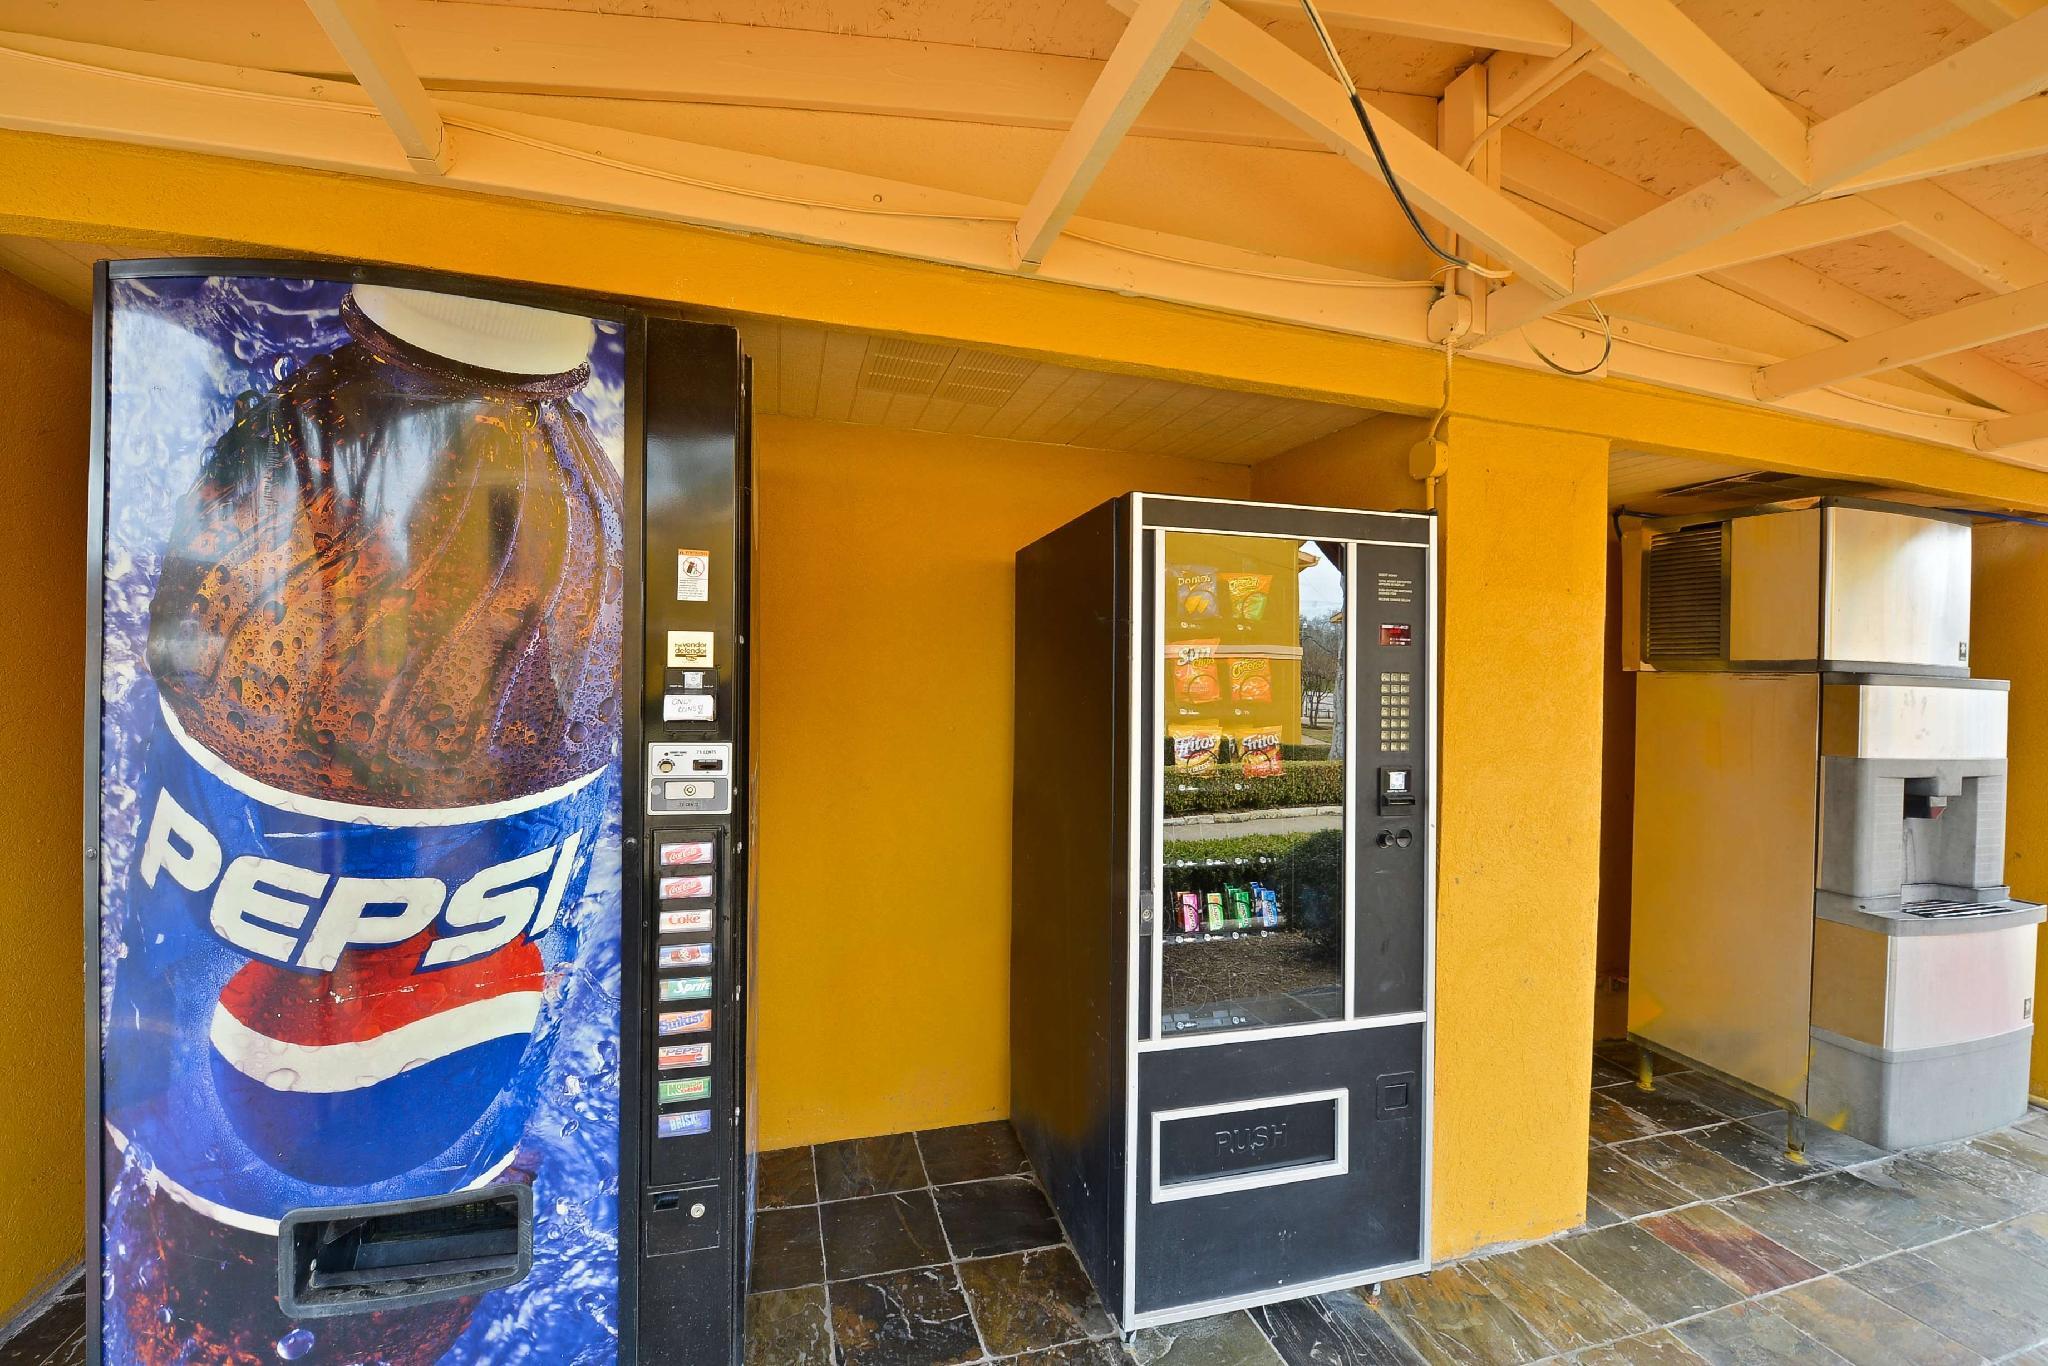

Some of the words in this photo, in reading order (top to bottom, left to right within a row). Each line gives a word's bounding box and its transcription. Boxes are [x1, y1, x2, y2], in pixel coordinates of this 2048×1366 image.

[140, 786, 584, 973] PEPSI
[674, 980, 712, 993] Sprite
[666, 1047, 703, 1055] PEPSI
[1215, 1123, 1287, 1154] PUSH
